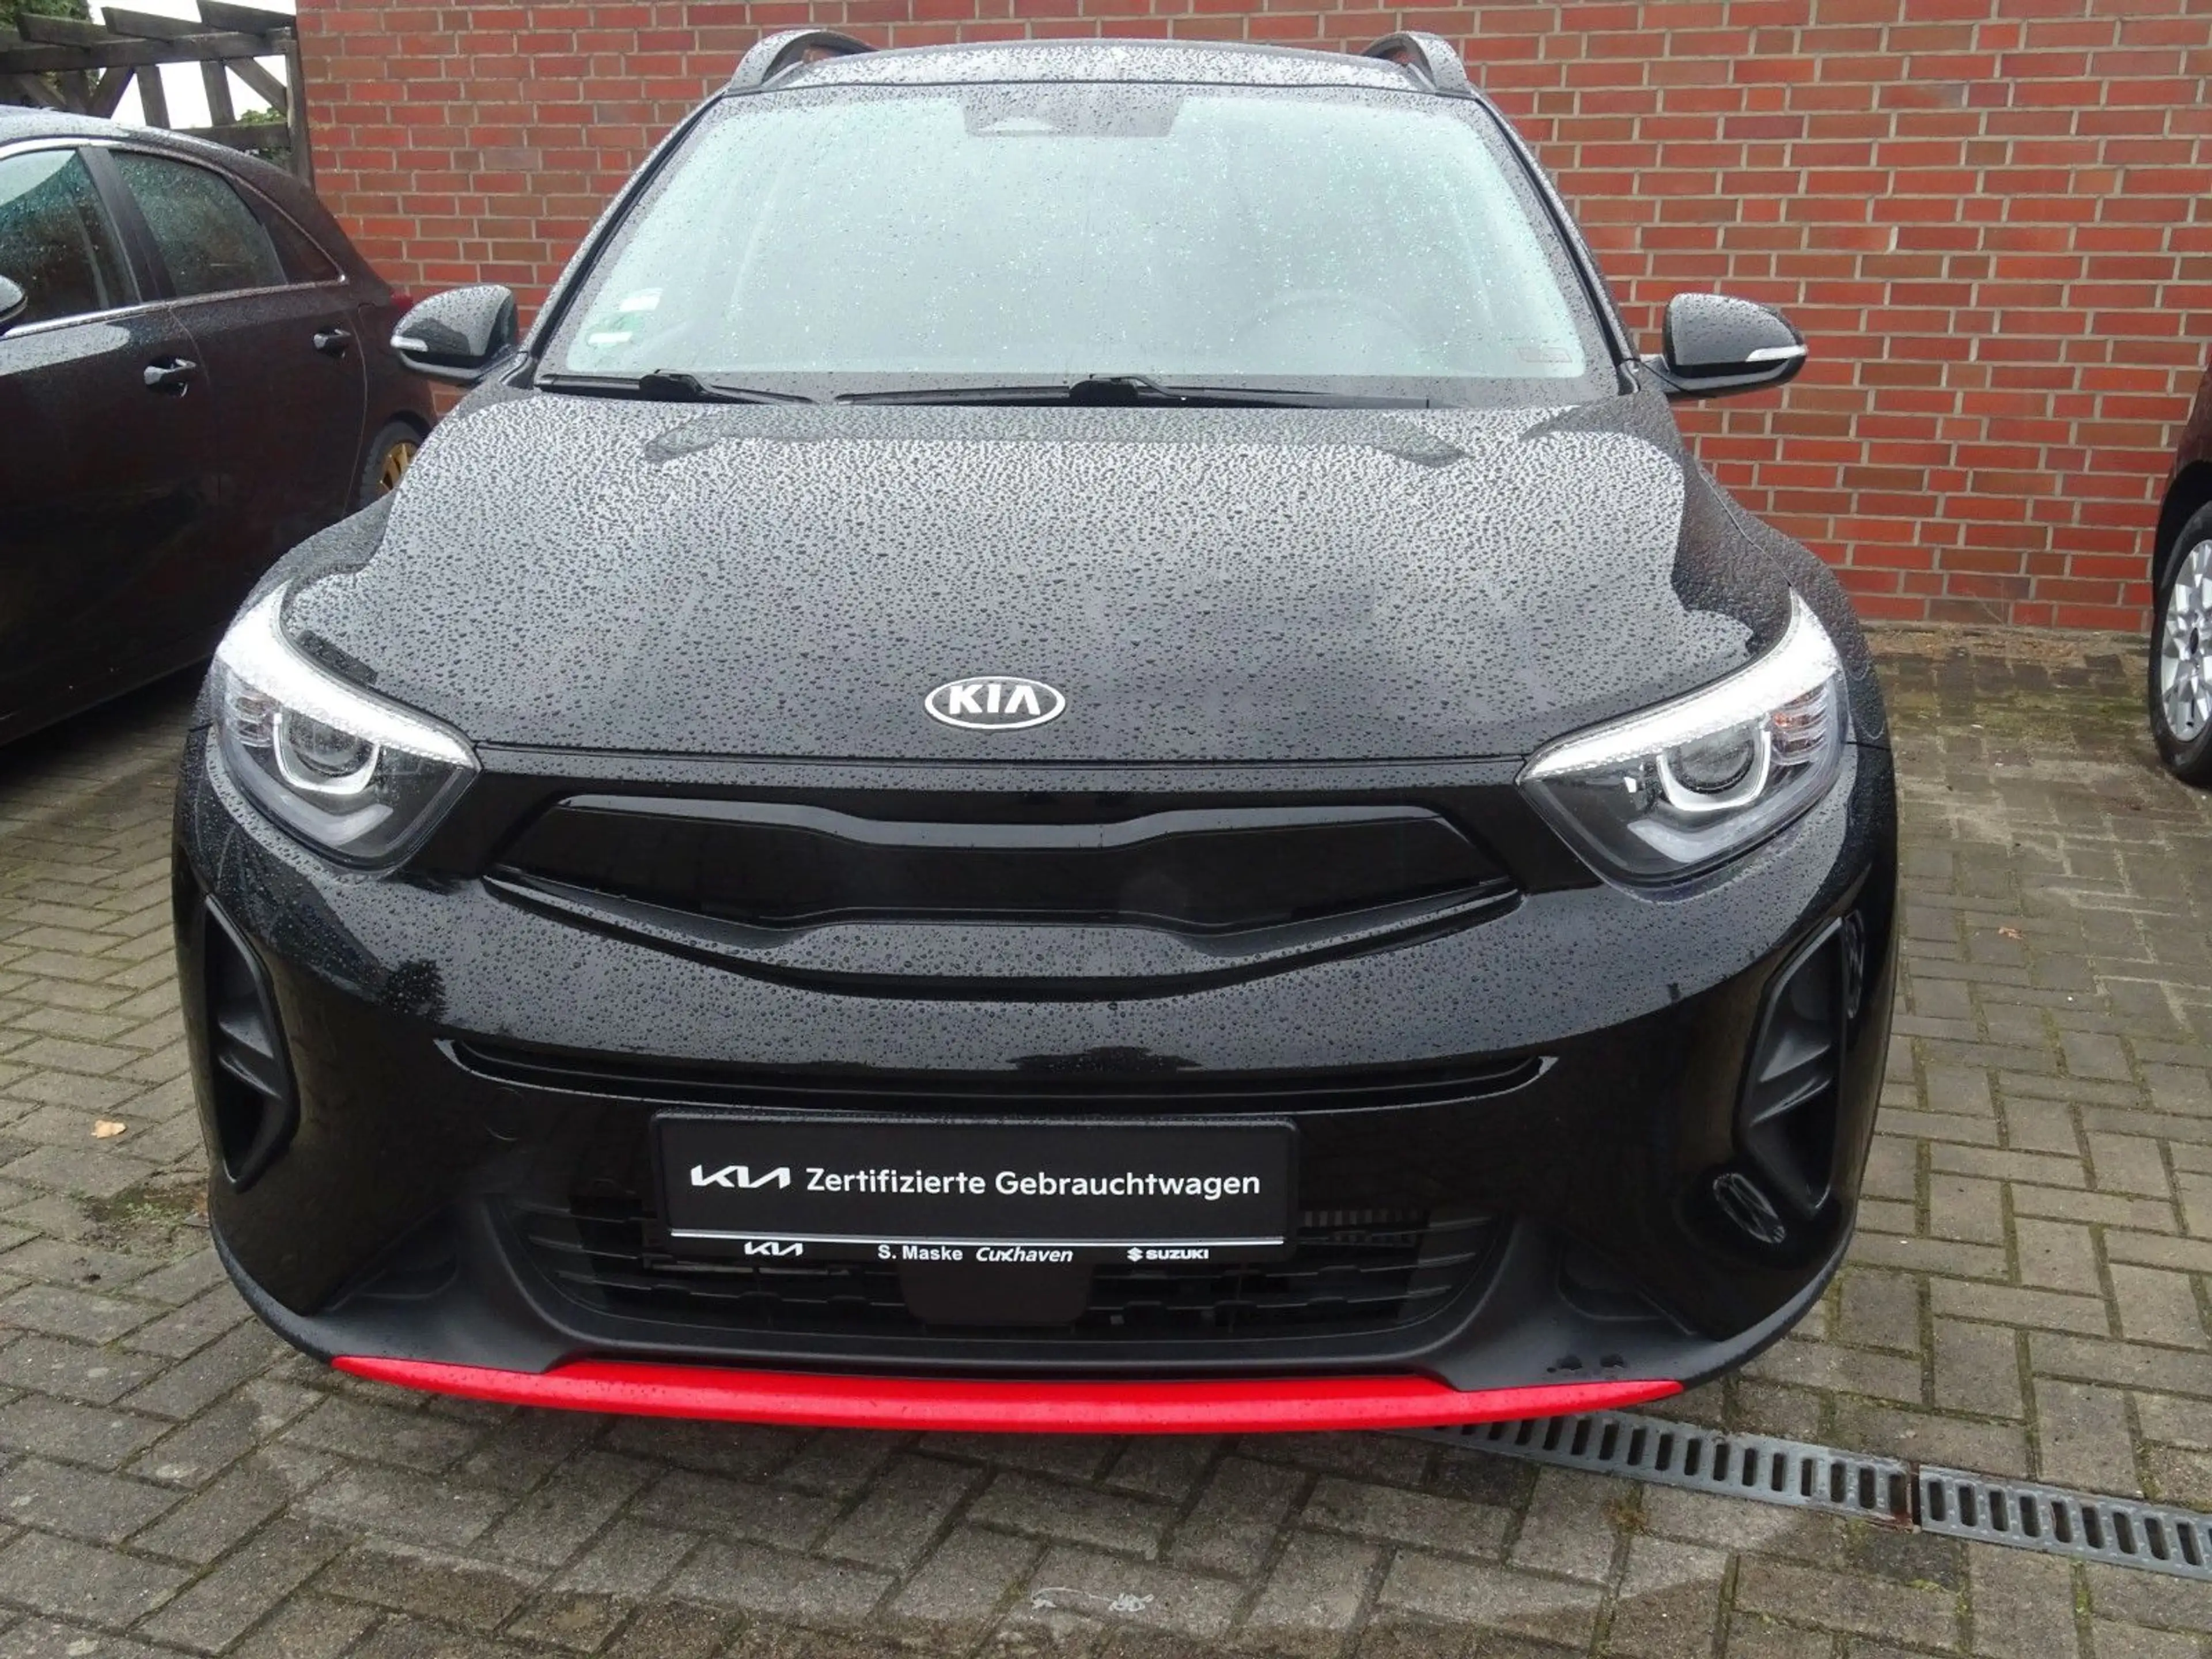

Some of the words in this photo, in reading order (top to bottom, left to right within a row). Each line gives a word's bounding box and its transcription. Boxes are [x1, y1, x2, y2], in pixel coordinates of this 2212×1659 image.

[949, 684, 1041, 715] KIA
[690, 1164, 791, 1190] KIA
[806, 1168, 986, 1194] Zertifizierte
[995, 1171, 1260, 1201] Gebrauchtwagen
[744, 1241, 803, 1257] KIA
[877, 1244, 896, 1259] S.
[902, 1245, 963, 1261] Maske
[975, 1247, 1074, 1262] Cuxhaven
[1145, 1249, 1209, 1260] SUZUKI
